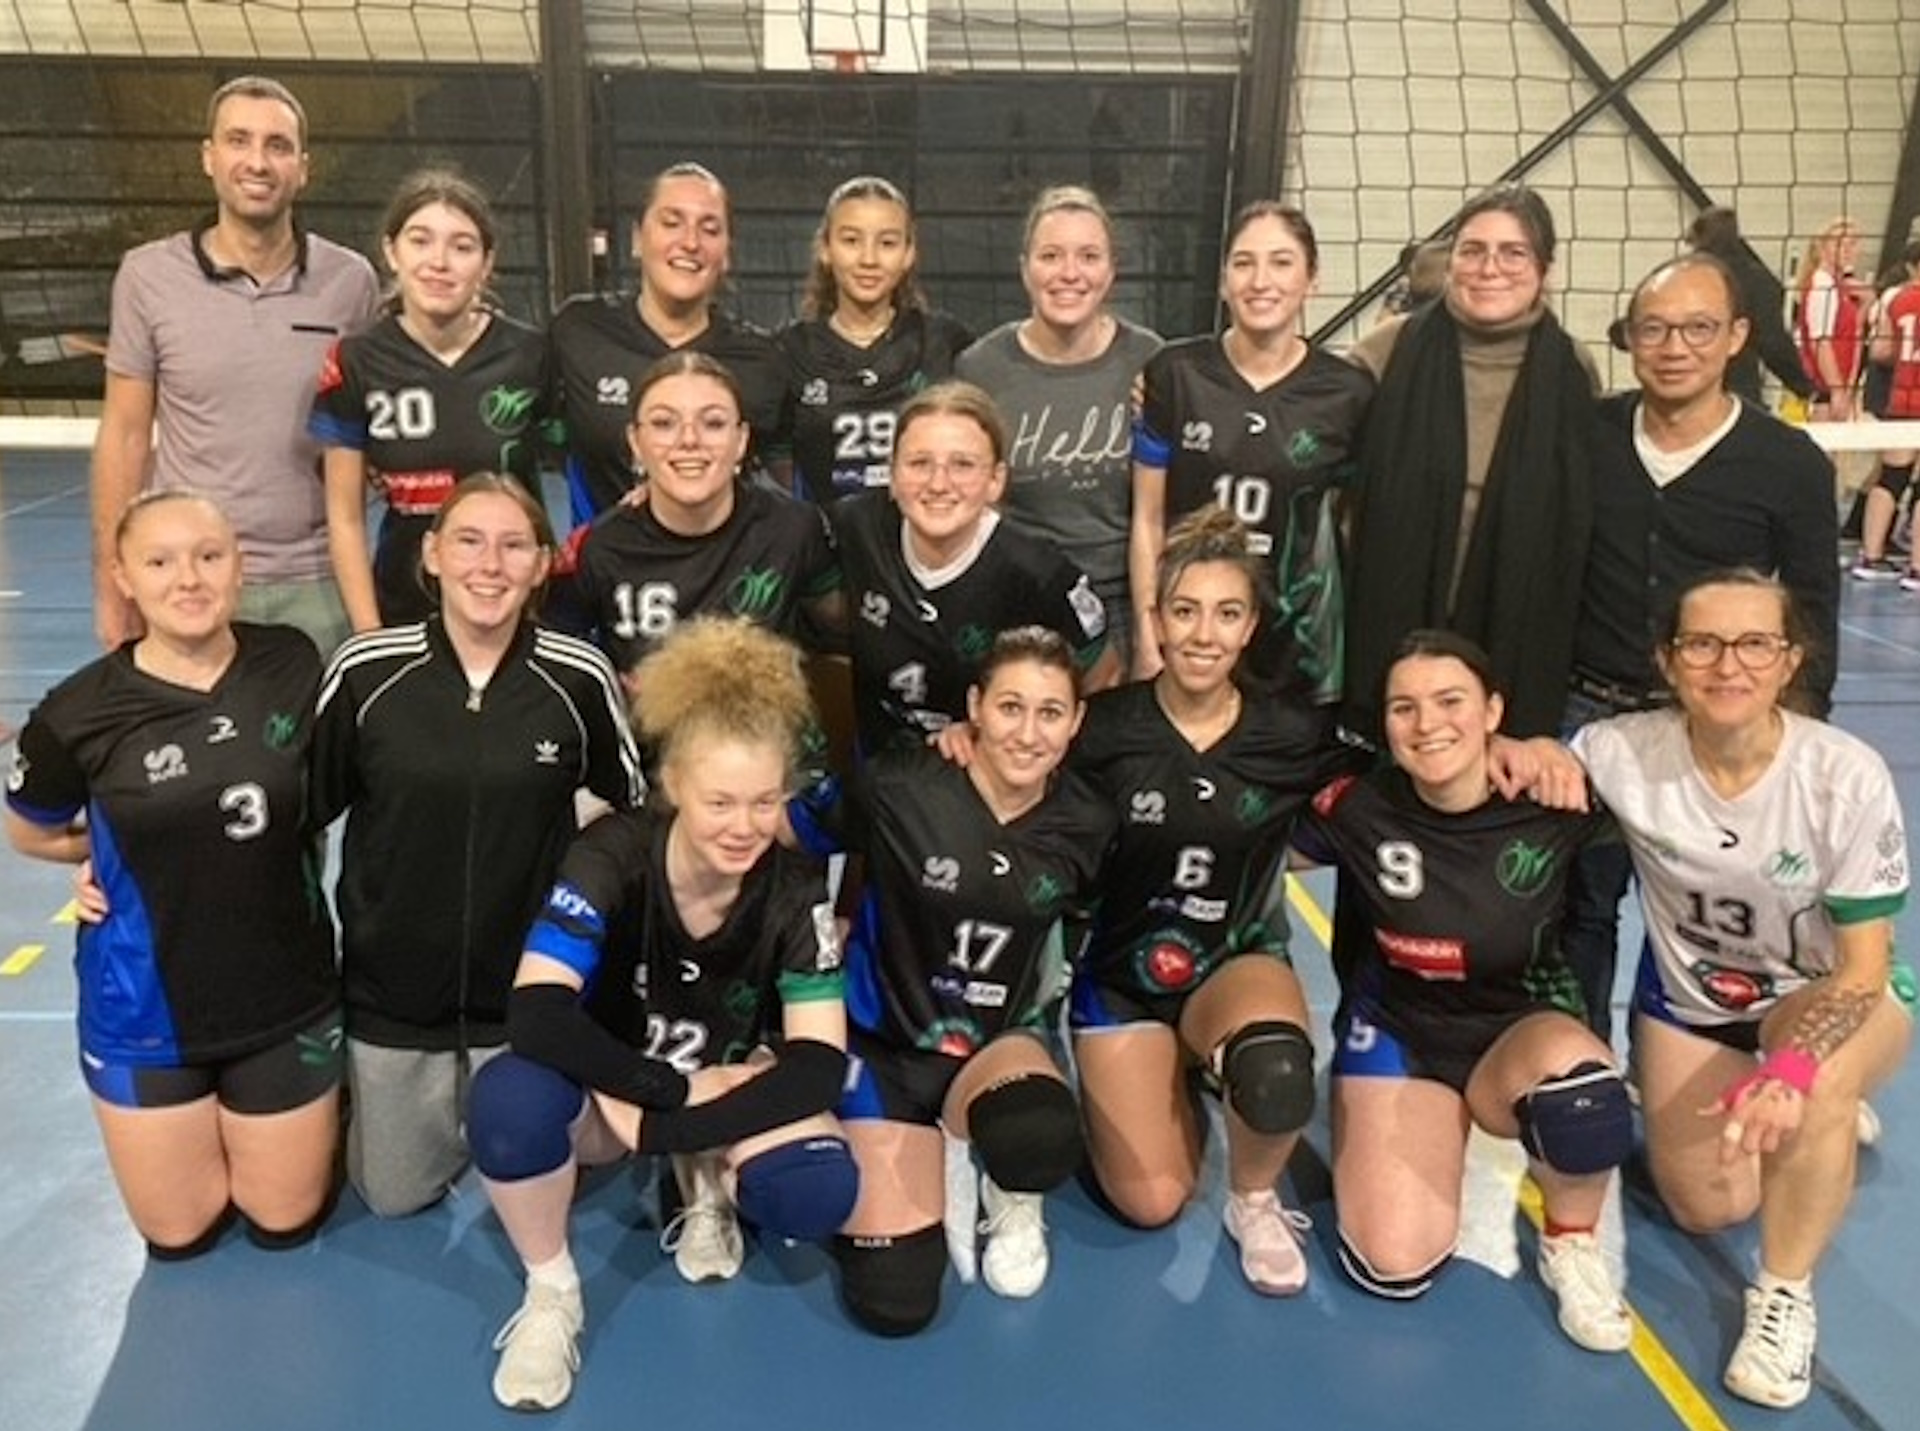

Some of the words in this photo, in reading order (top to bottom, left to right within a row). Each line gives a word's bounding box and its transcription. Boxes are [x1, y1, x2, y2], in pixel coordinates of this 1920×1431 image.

[1896, 313, 1920, 362] 1
[366, 388, 436, 440] 20
[832, 410, 898, 460] 29
[1213, 474, 1271, 525] 10
[613, 581, 679, 639] 16
[888, 662, 928, 703] 4
[217, 782, 270, 841] 3
[1172, 844, 1218, 892] 6
[1375, 840, 1424, 900] 9
[1686, 891, 1755, 940] 13
[948, 918, 1015, 972] 17
